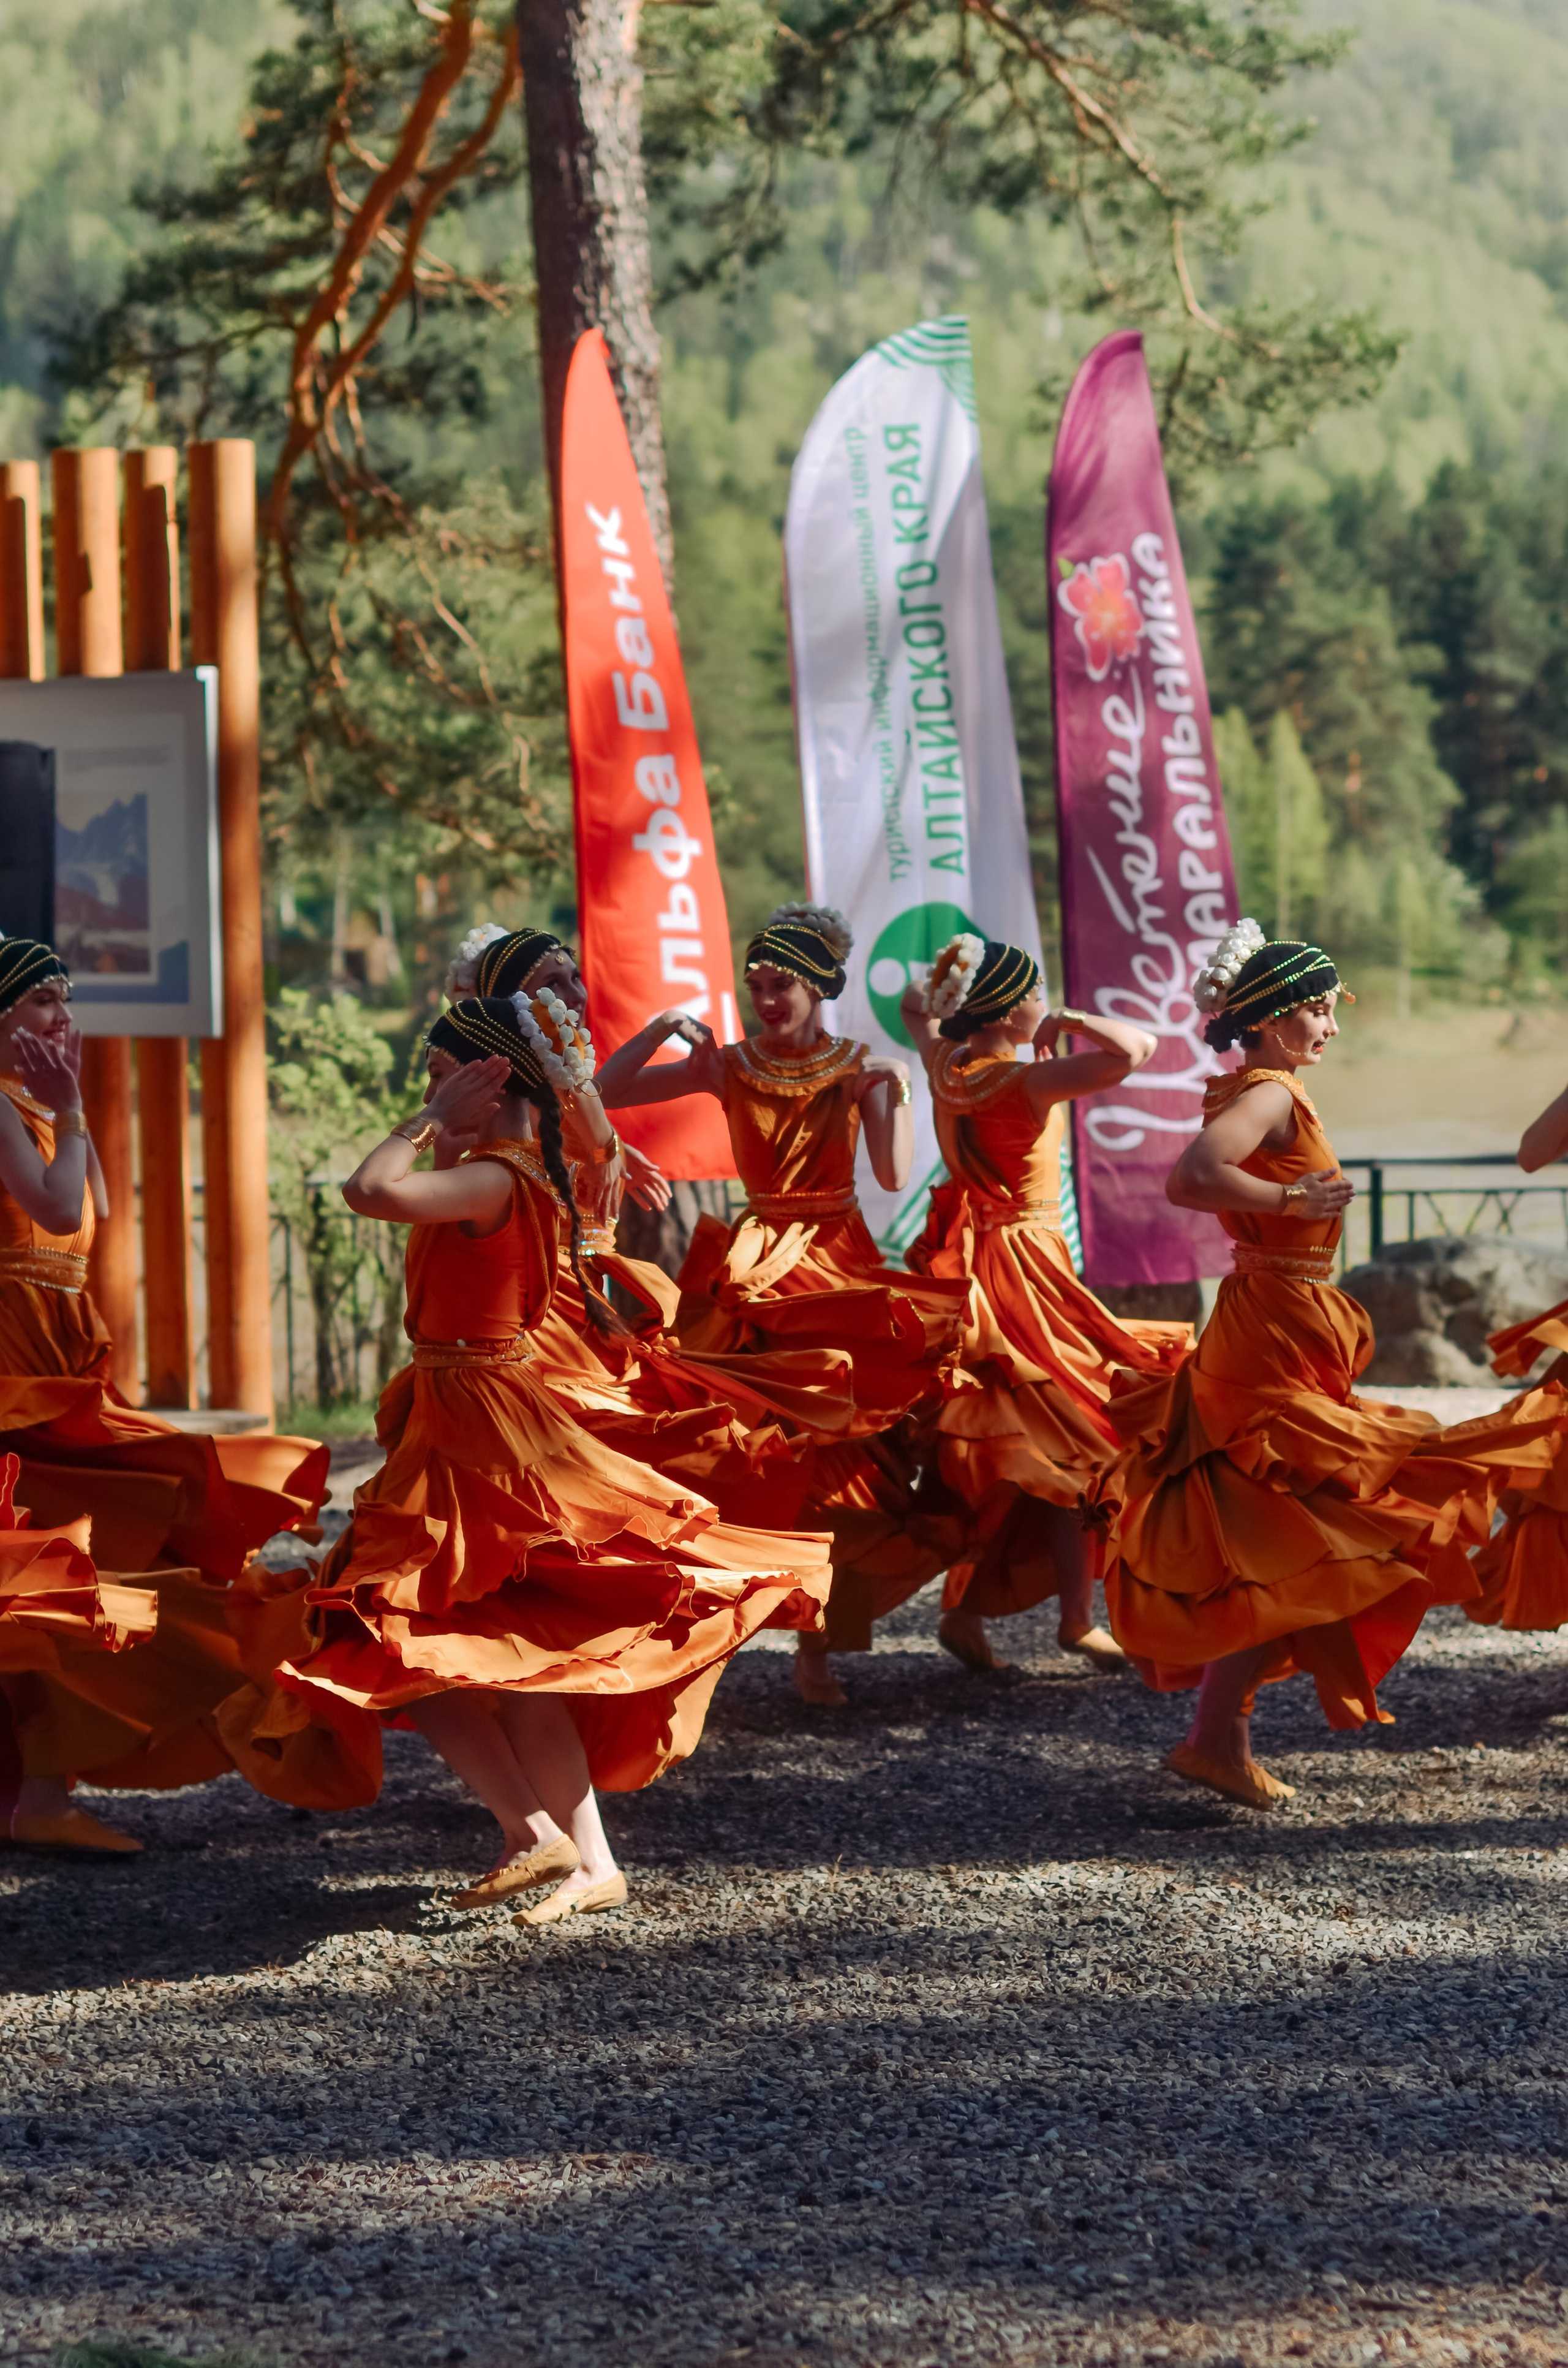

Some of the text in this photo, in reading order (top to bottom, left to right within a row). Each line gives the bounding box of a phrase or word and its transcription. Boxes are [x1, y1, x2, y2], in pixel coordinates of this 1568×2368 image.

[844, 426, 869, 499] центр
[584, 499, 670, 732] Банк
[848, 507, 894, 731] информационный
[883, 423, 966, 876] АЛТАЙСКОГО КРАЯ
